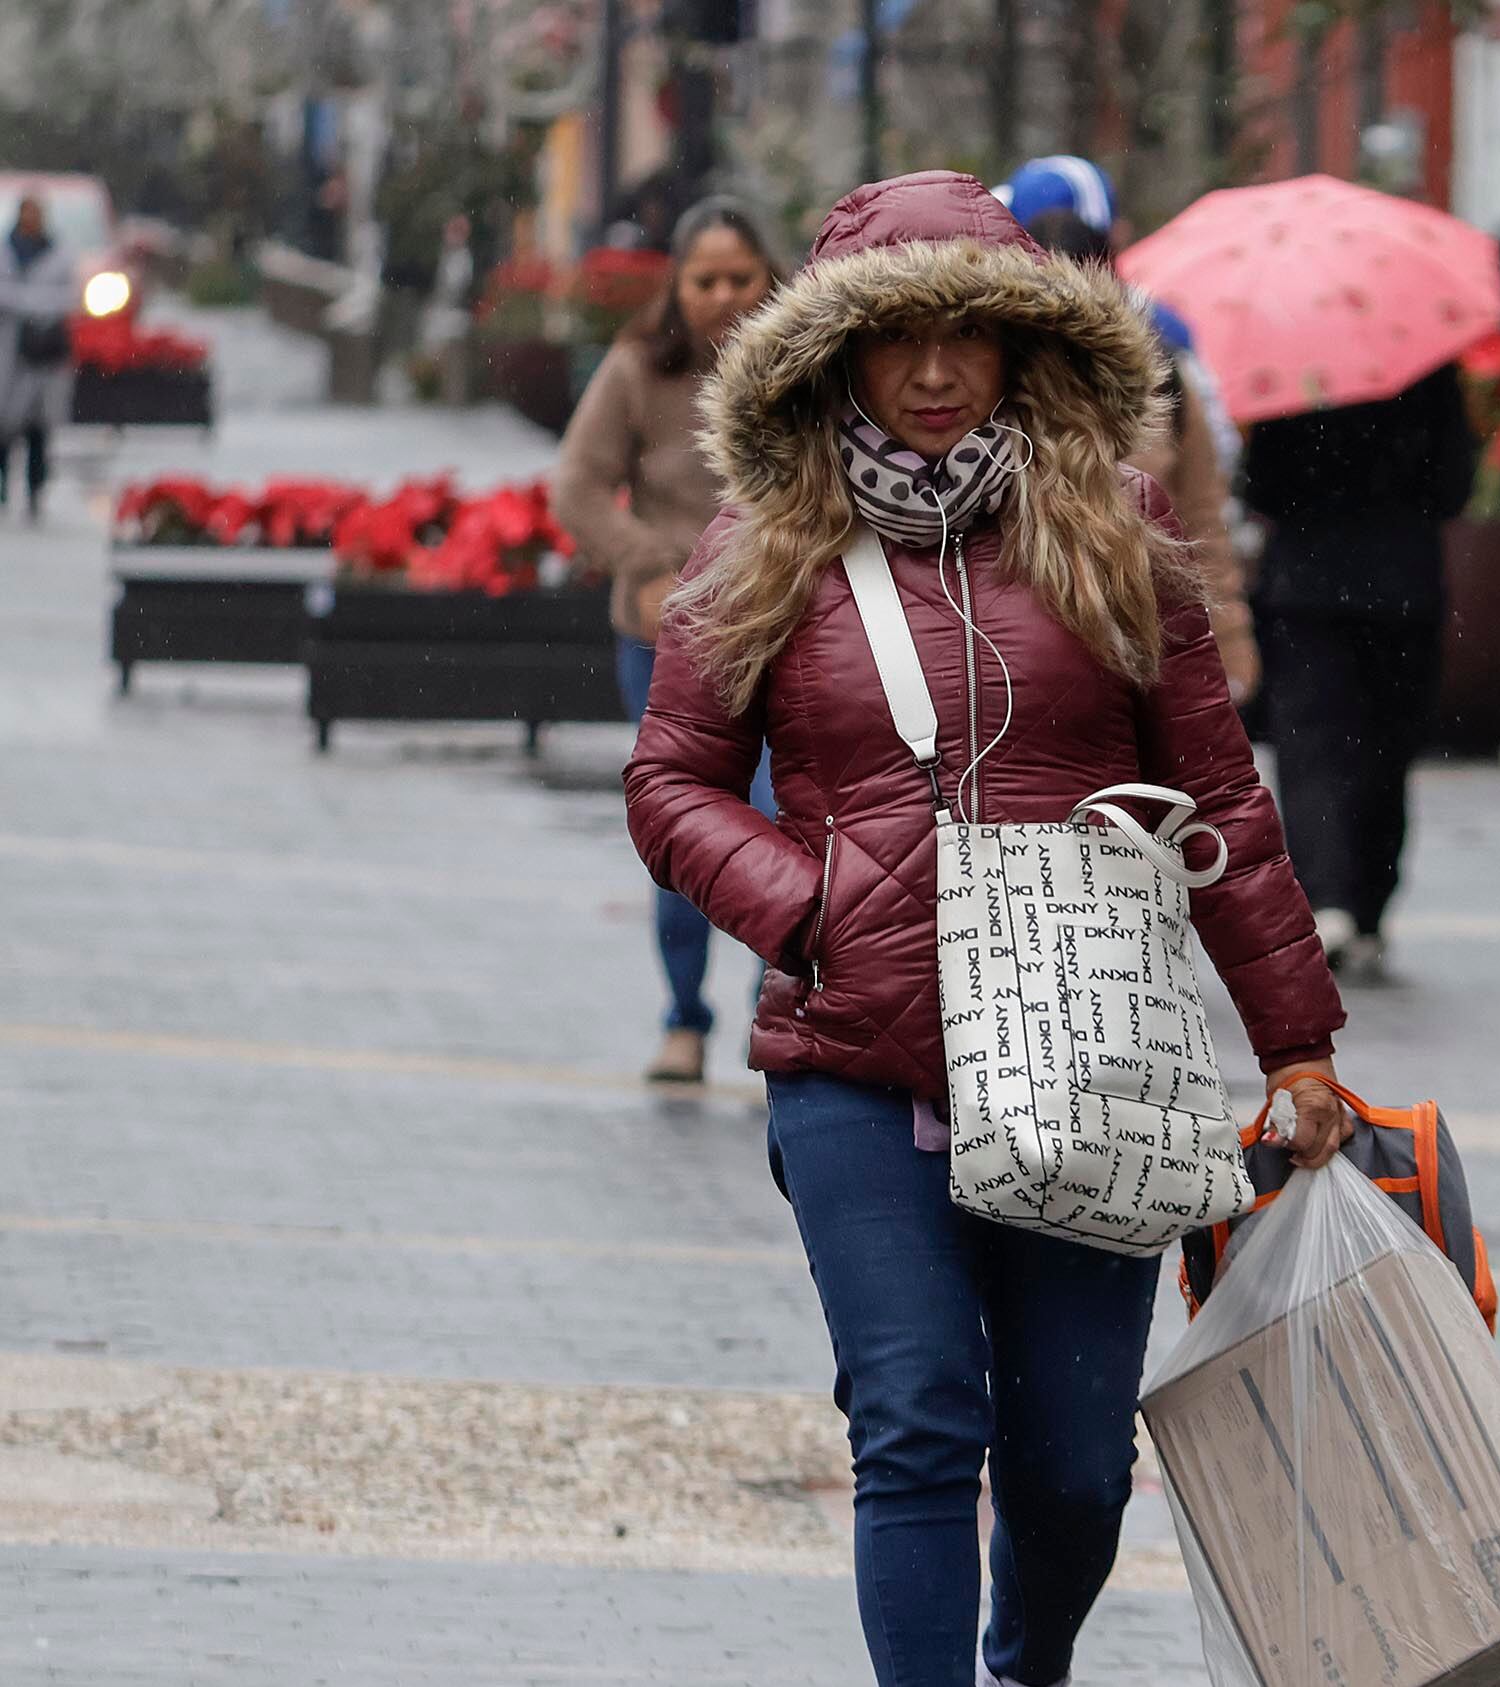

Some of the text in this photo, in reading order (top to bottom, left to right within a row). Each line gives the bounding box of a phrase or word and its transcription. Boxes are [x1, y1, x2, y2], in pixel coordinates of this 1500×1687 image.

[1036, 823, 1089, 835] DKNY
[958, 826, 973, 879] DKNY
[1002, 844, 1029, 856] NY
[1100, 844, 1144, 860] DKNY
[982, 867, 1005, 879] NY
[1037, 844, 1055, 897] DKNY
[1080, 844, 1096, 898] DKNY
[937, 885, 976, 903] KNY
[1007, 885, 1034, 896] DK
[1105, 885, 1149, 901] DKNY
[1153, 865, 1163, 906] DKN
[986, 882, 1002, 936] DKNY
[1046, 903, 1099, 914] DKNY
[1107, 902, 1119, 927] NY
[1142, 908, 1152, 932] DK
[1024, 903, 1042, 955] DKNY
[1158, 911, 1180, 932] DKNY
[937, 927, 978, 947] DKN
[1084, 927, 1136, 940] DKNY
[990, 946, 1015, 958] DK
[1063, 925, 1080, 980] DKNY
[1141, 928, 1152, 984] DKNY
[968, 947, 983, 1002] DKNY
[1017, 961, 1045, 973] NY
[1088, 968, 1138, 983] DKNY
[992, 987, 1020, 1000] NY
[1145, 994, 1177, 1014] DKNY
[1022, 1001, 1049, 1013] DK
[1089, 988, 1106, 1043] DKNY
[995, 1004, 1010, 1058] DKNY
[1128, 993, 1141, 1048] DKNY
[1180, 1004, 1193, 1060] DKNY
[1039, 1020, 1056, 1072] DKNY
[1145, 1038, 1182, 1057] DKNY
[998, 1065, 1027, 1079] DK
[1079, 1051, 1092, 1091] DKN
[1098, 1053, 1142, 1072] DKNY
[1032, 1078, 1058, 1090] NY
[1138, 1059, 1154, 1103] KNY
[1168, 1066, 1181, 1111] DKN
[1187, 1071, 1217, 1090] DKNY
[976, 1069, 992, 1124] DKNY
[1067, 1078, 1081, 1133] DKNY
[1037, 1119, 1060, 1131] DK
[1100, 1094, 1110, 1140] KNY
[1116, 1128, 1155, 1147] DKNY
[1161, 1108, 1171, 1151] DKN
[1190, 1114, 1200, 1158] KNY
[954, 1131, 996, 1156] DKNY
[1003, 1124, 1031, 1176] DKNY
[1072, 1139, 1111, 1157] DKNY
[1102, 1147, 1122, 1204] DKNY
[1160, 1156, 1200, 1174] DKNY
[974, 1171, 1016, 1194] DKNY
[1059, 1181, 1100, 1199] DKNY
[1131, 1154, 1153, 1210] DKNY
[1195, 1164, 1214, 1219] DKNY
[1231, 1171, 1243, 1213] DKN
[1090, 1210, 1136, 1226] DKNY
[1147, 1199, 1191, 1216] DKNY
